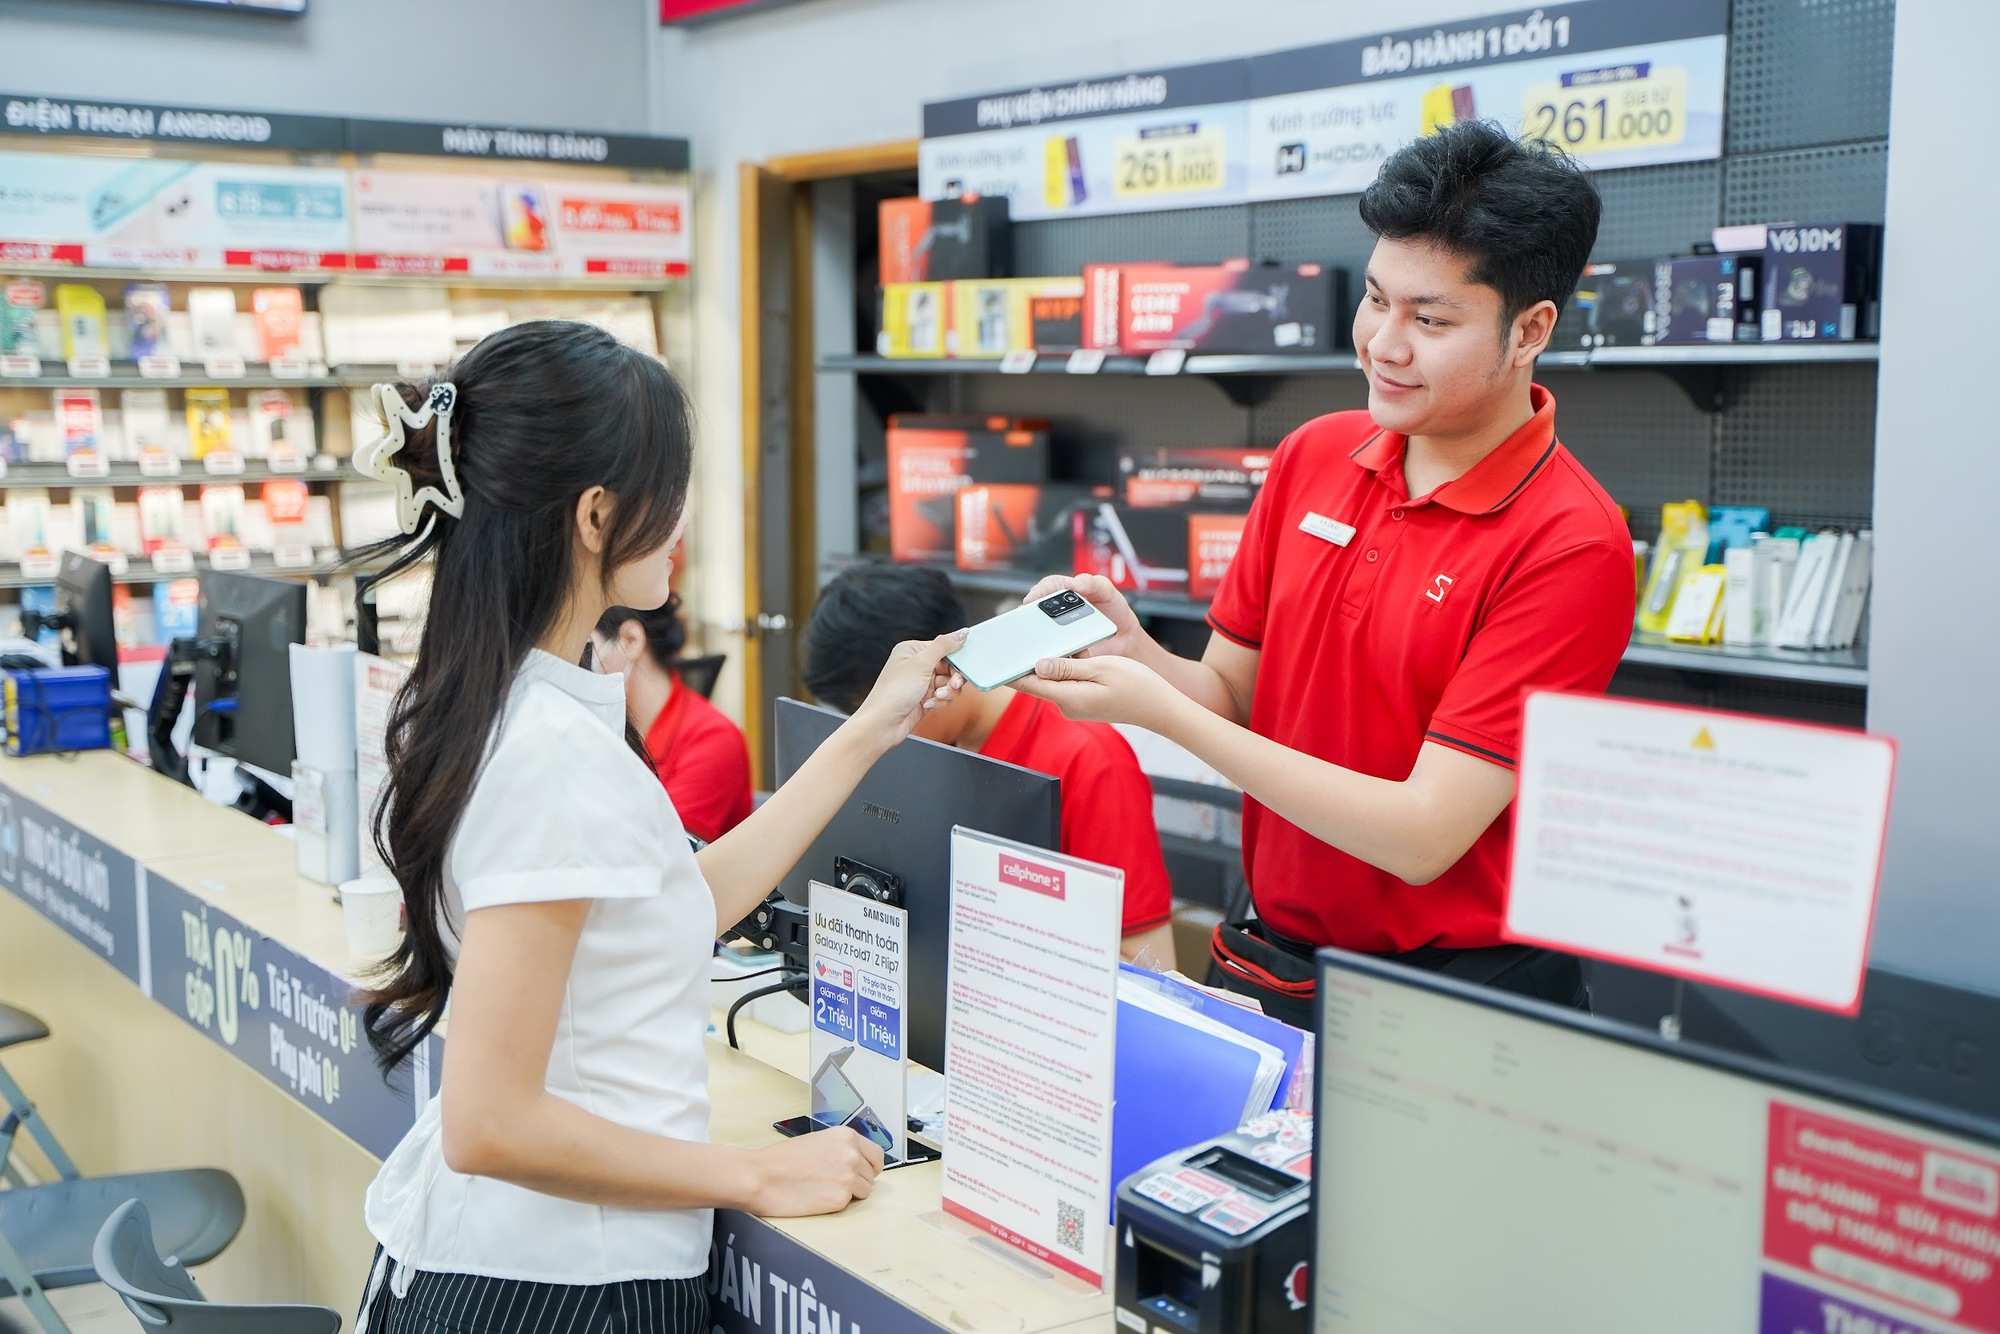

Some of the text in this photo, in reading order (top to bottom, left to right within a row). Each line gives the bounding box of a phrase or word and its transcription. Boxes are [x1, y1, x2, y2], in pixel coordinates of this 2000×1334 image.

[1361, 9, 1570, 77] BẢO HÀNH 1 ĐỔI 1
[5, 98, 271, 142] ĐIỆN THOẠI ANDROID
[1768, 226, 1842, 253] V610M
[862, 801, 901, 824] SAMSUNG
[815, 912, 899, 954] Ưu đãi thanh toán
[863, 906, 900, 928] SAMSUNG
[182, 906, 213, 972] TRẢ
[814, 933, 844, 956] Galaxy
[844, 945, 849, 955] Z
[849, 947, 871, 962] Fold7
[881, 955, 899, 975] Flip7
[185, 968, 215, 1030] GÓP
[214, 926, 260, 1046] 0%
[266, 962, 292, 1019] Trả
[290, 975, 339, 1048] Trước
[820, 986, 849, 1005] Giảm đến
[816, 997, 853, 1031] 2 Triệu
[861, 1014, 896, 1049] 1 Triệu
[870, 1005, 887, 1021] Giảm
[269, 1022, 298, 1090] Phụ
[299, 1046, 322, 1098] phí
